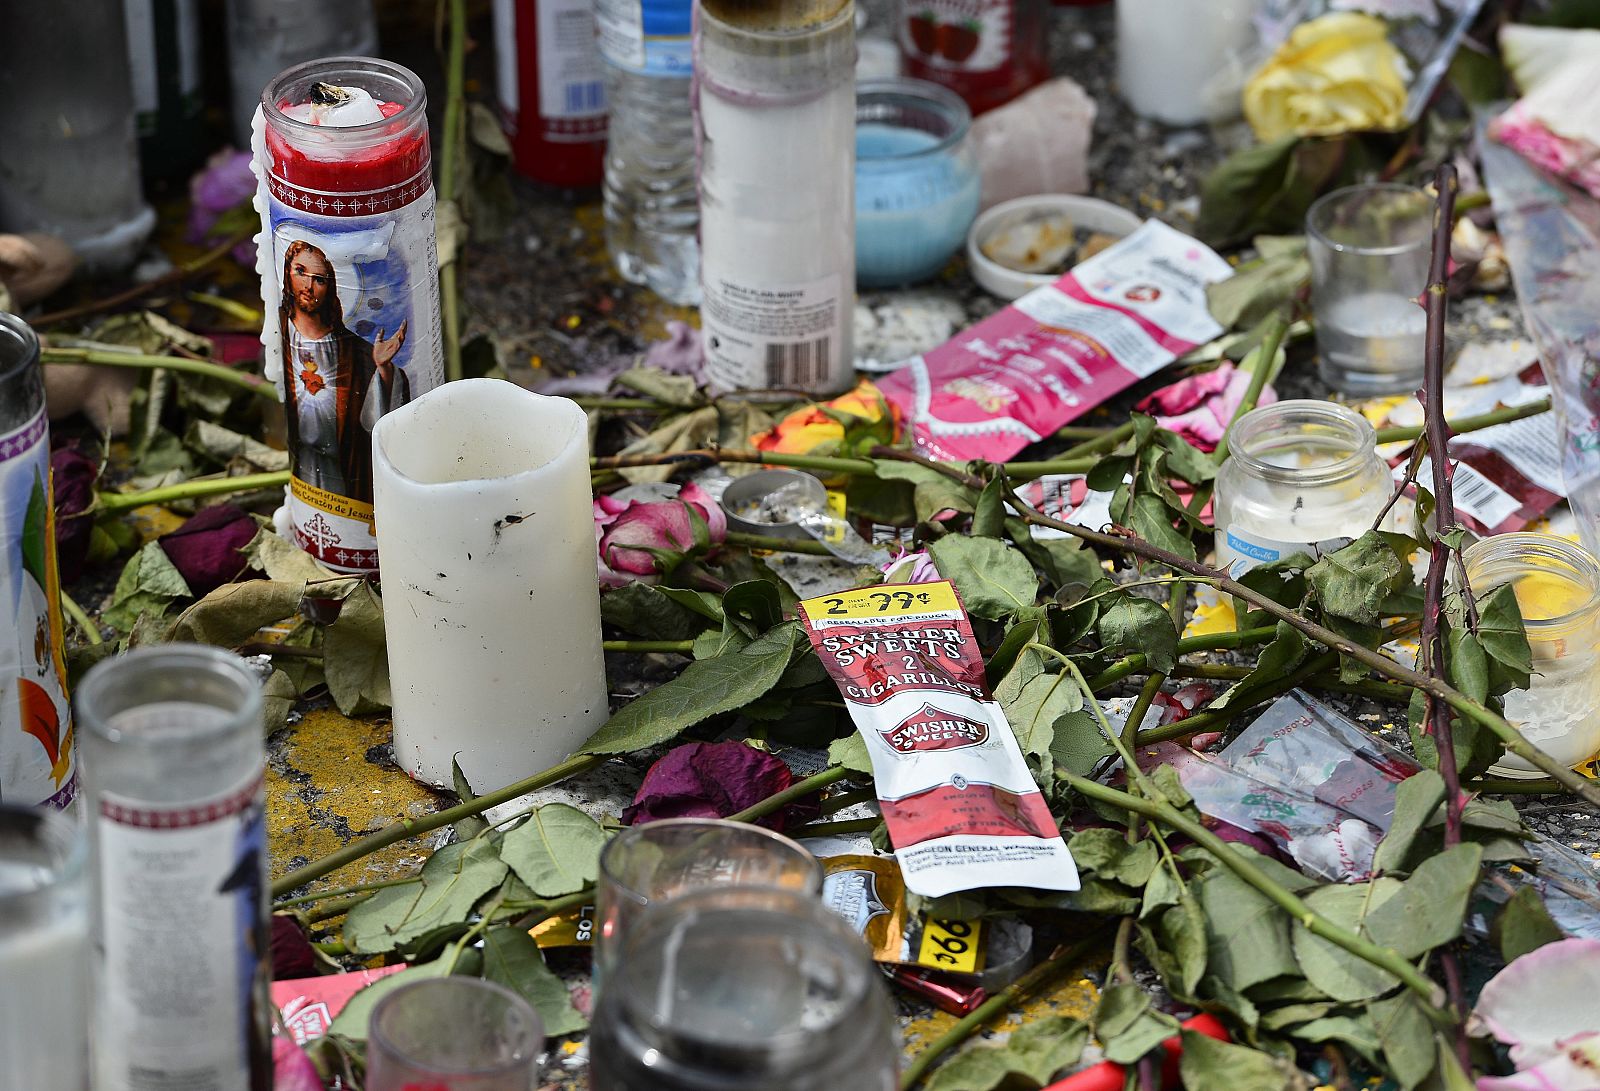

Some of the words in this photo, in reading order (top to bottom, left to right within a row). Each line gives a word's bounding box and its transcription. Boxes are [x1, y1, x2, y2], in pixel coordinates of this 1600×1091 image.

[308, 486, 323, 497] Heart
[331, 495, 349, 505] Jesus
[335, 504, 346, 514] de
[347, 506, 375, 520] Jesus
[823, 598, 848, 615] 2
[822, 628, 967, 653] SWISHER
[835, 638, 962, 667] SWEETS
[902, 656, 918, 671] 2
[847, 671, 985, 699] CIGARILLOS
[892, 720, 982, 747] SWISHER
[903, 731, 977, 750] SWEETS
